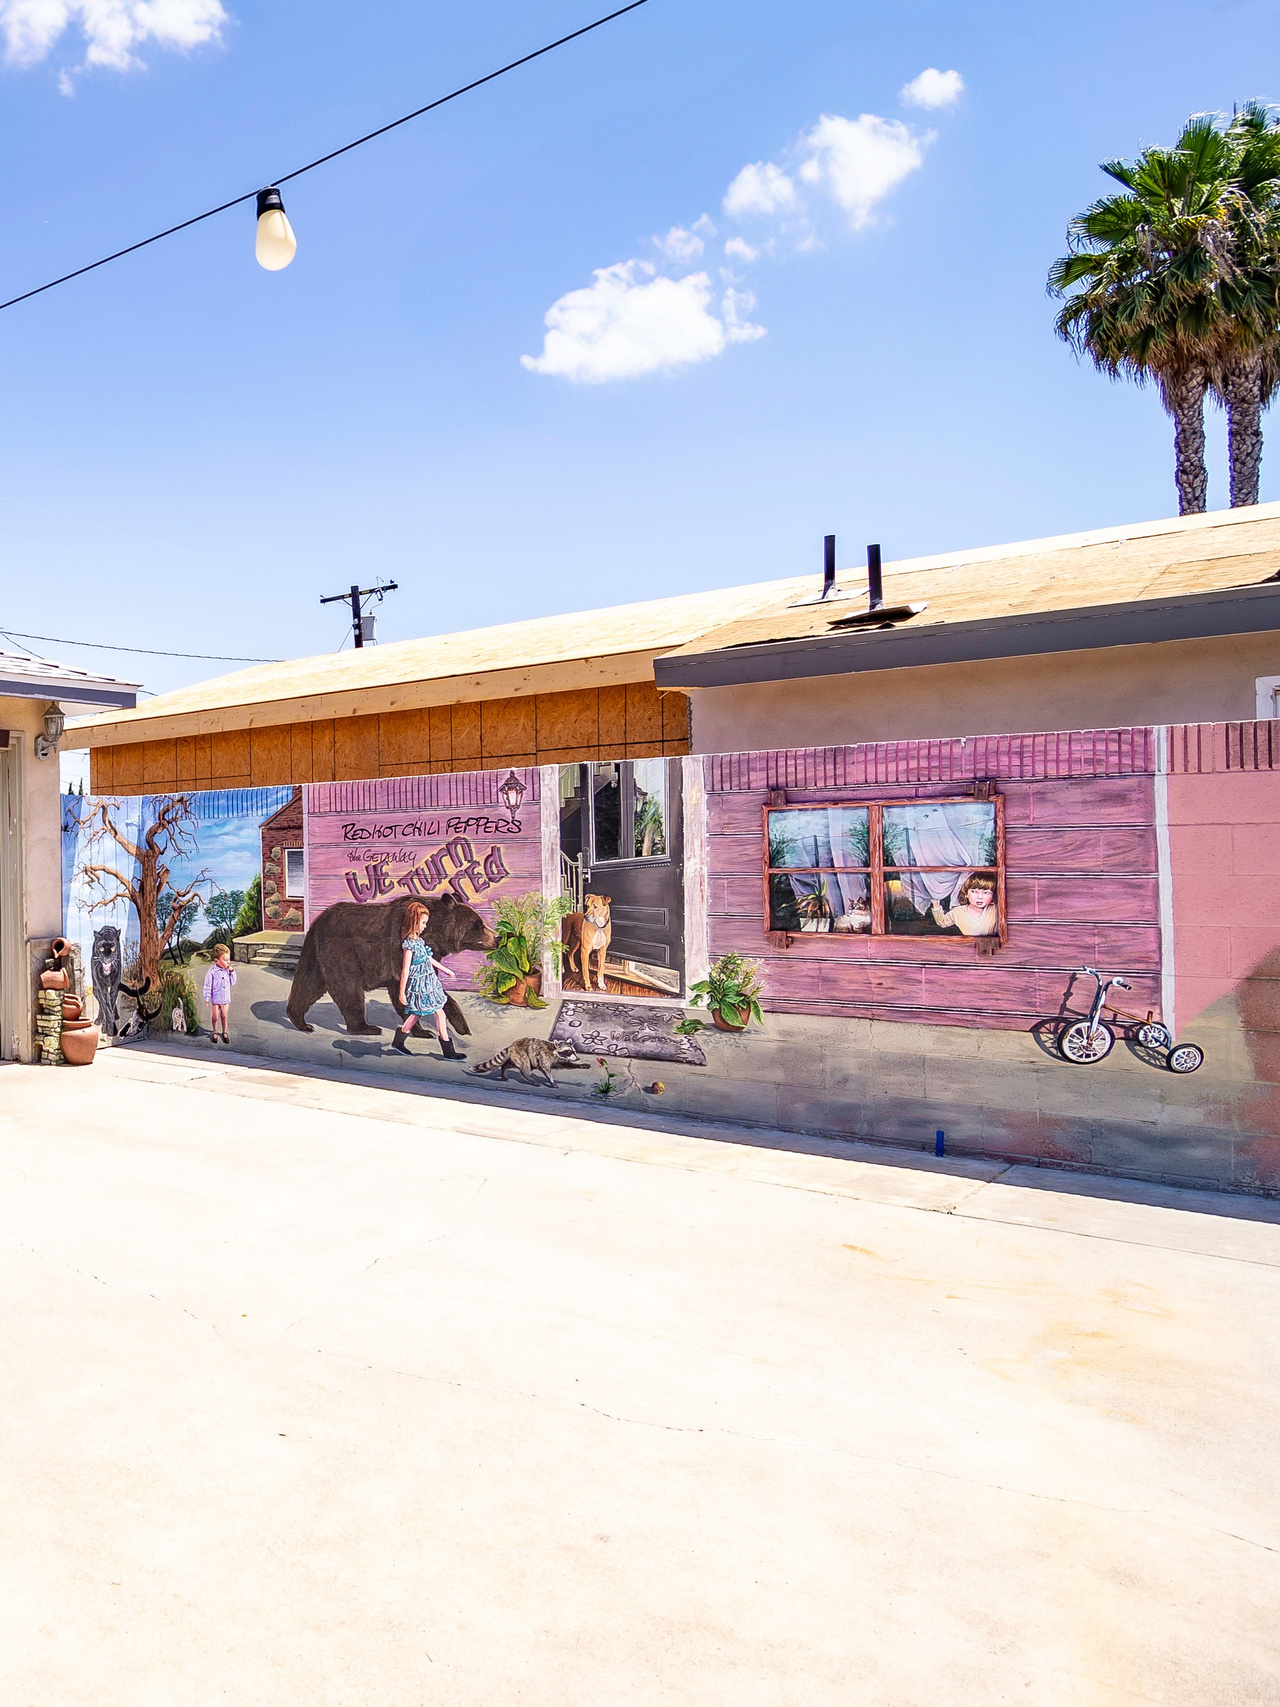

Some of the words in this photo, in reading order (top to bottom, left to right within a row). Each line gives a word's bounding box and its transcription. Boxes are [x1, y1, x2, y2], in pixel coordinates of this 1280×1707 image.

[402, 820, 440, 836] CHILI
[445, 817, 522, 836] PEPPERS
[347, 848, 363, 862] the
